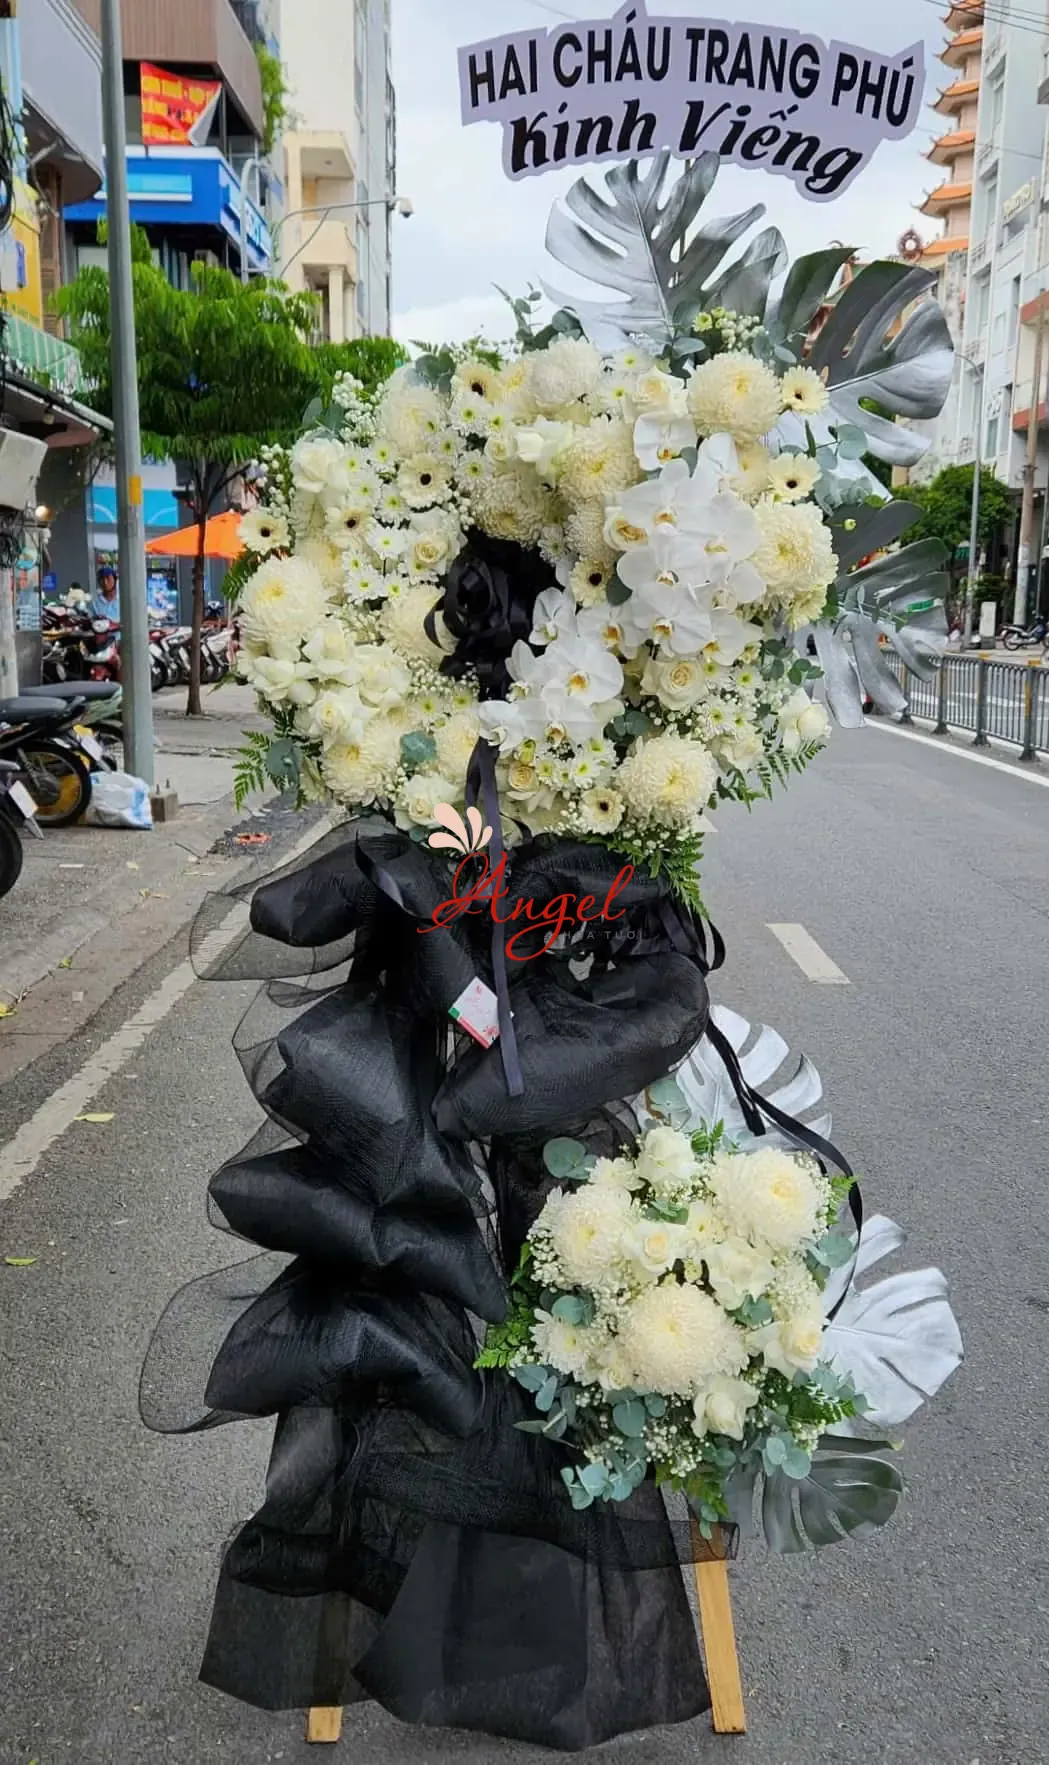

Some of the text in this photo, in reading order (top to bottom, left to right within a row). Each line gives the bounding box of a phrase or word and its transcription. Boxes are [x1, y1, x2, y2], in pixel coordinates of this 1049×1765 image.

[468, 9, 915, 127] HAI CHÁU TRANG PHÚ
[510, 98, 863, 195] Kính Viếng
